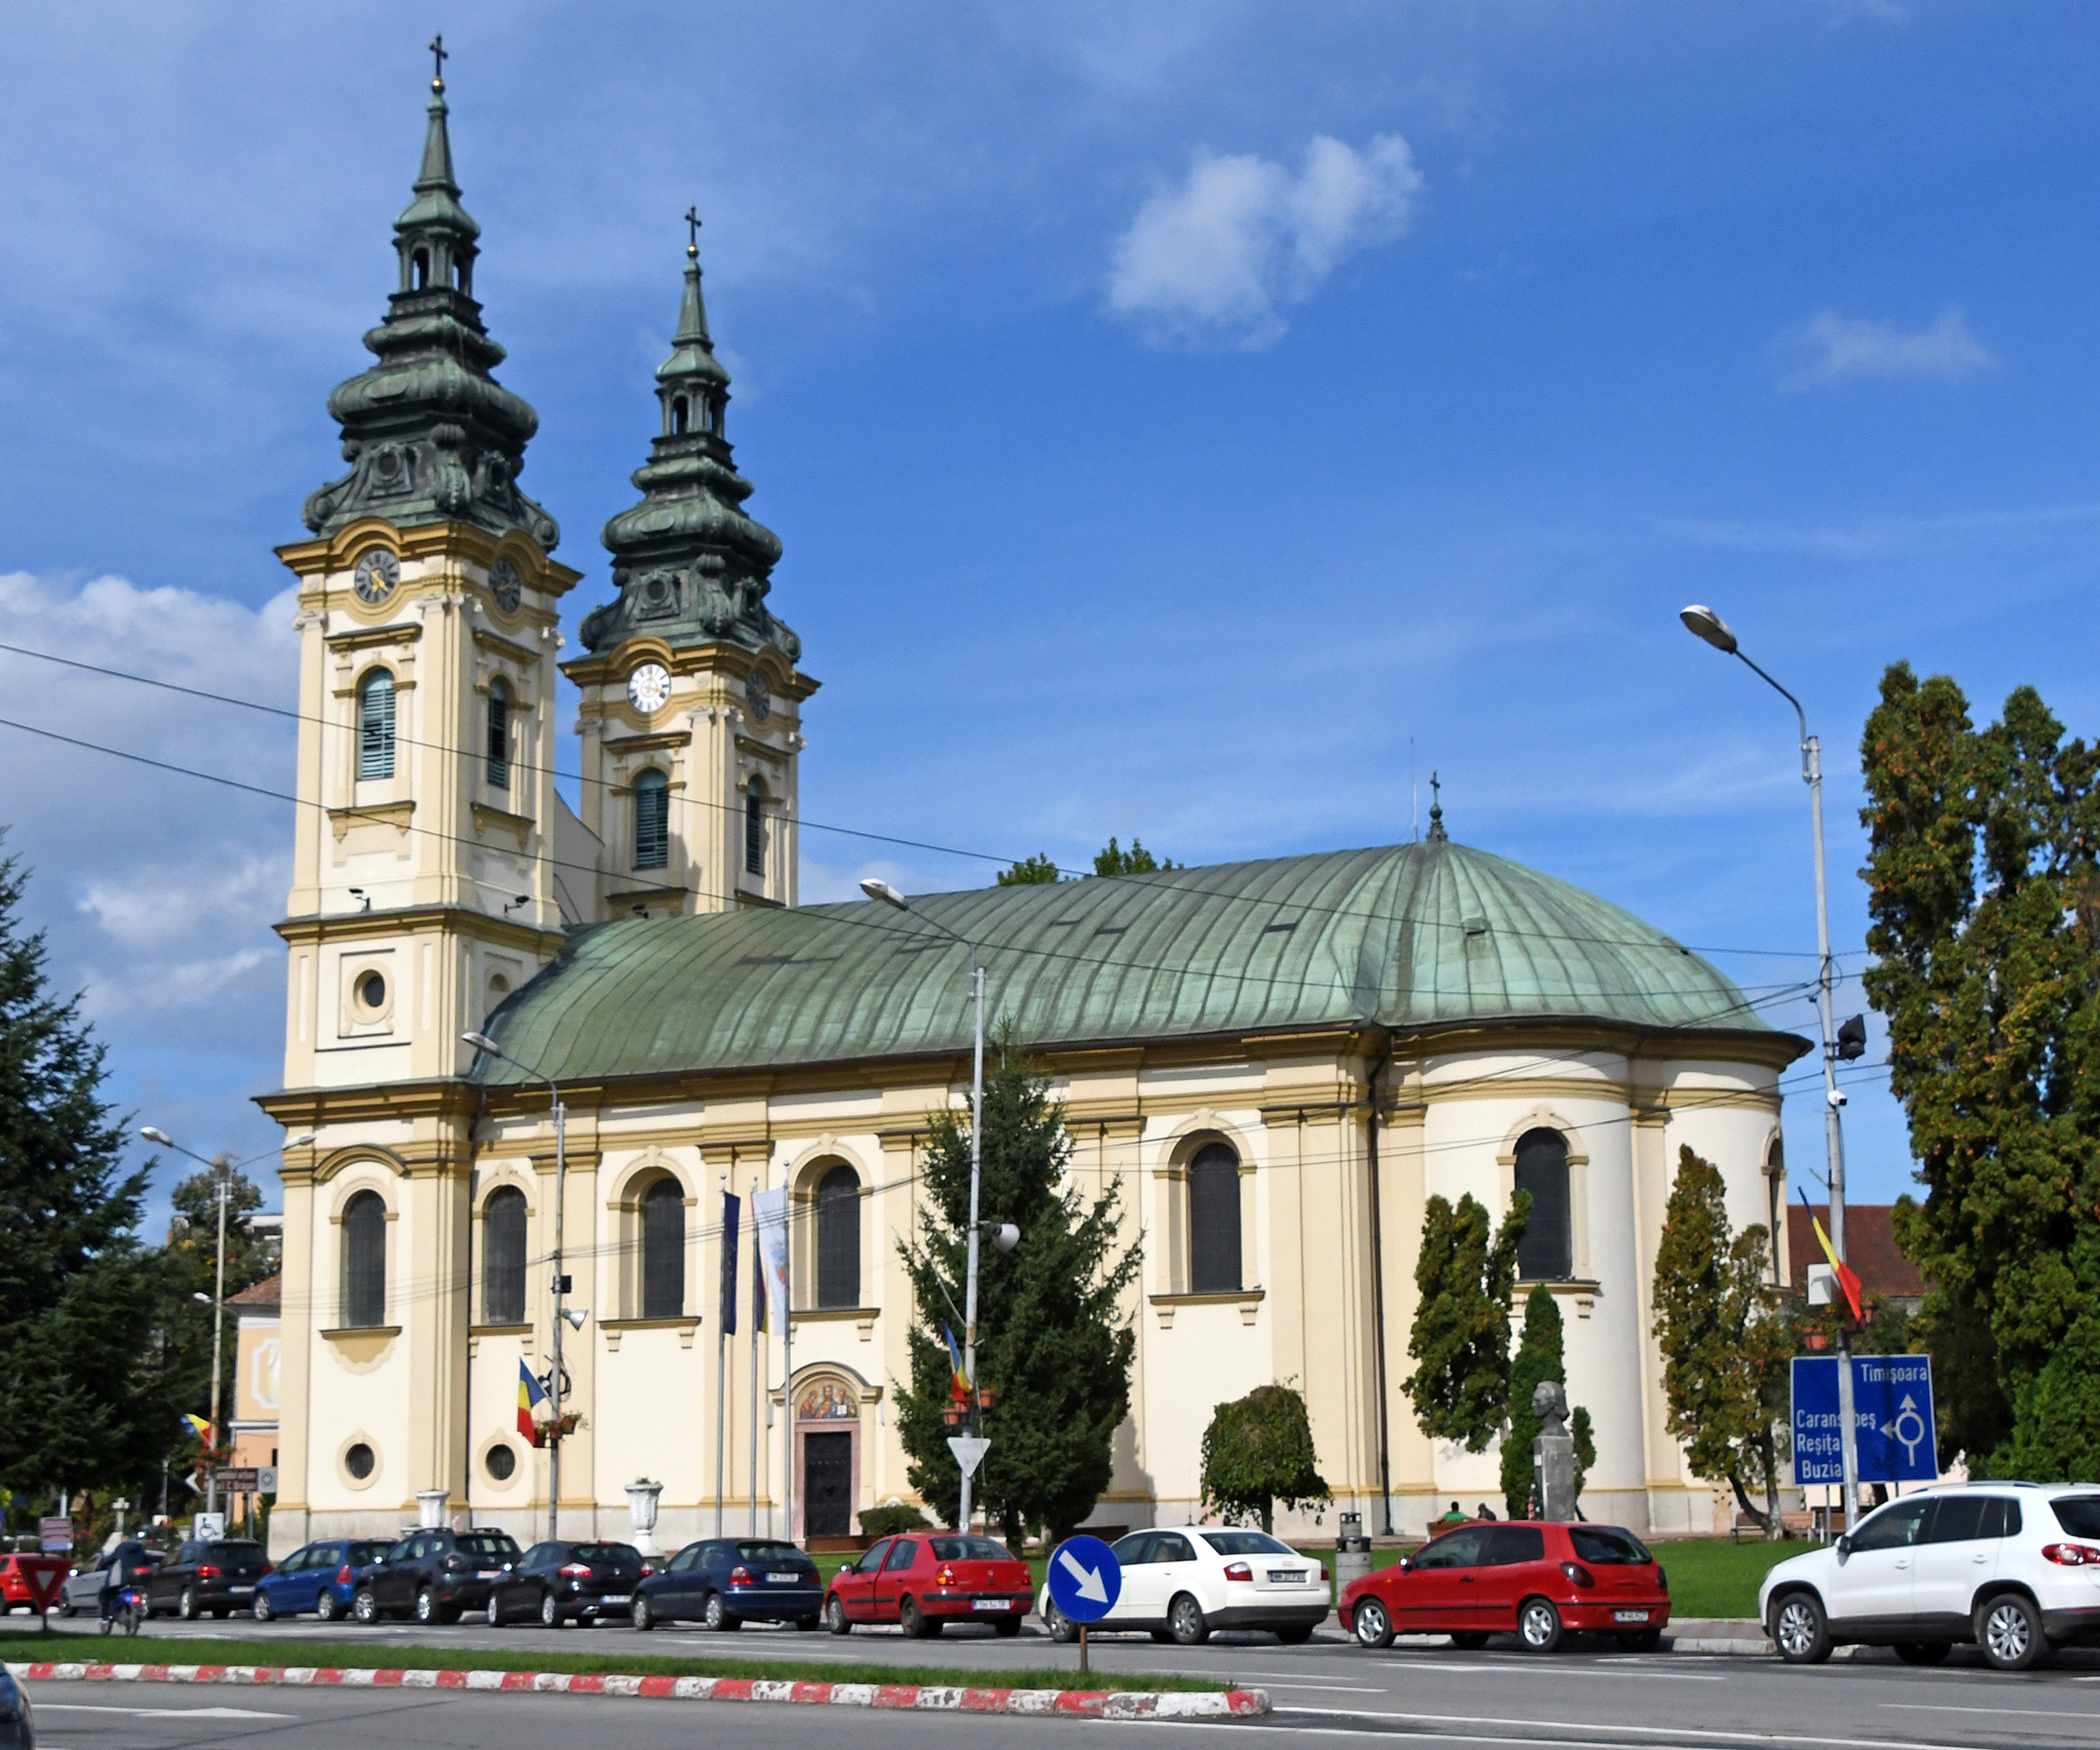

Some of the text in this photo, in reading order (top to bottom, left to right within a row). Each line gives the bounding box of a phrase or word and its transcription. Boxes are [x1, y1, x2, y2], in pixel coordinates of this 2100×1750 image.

[1860, 1363, 1928, 1384] Timișoara
[1796, 1409, 1876, 1431] Caransbeș
[1796, 1432, 1841, 1456] Reșița
[1802, 1459, 1843, 1480] Buzia
